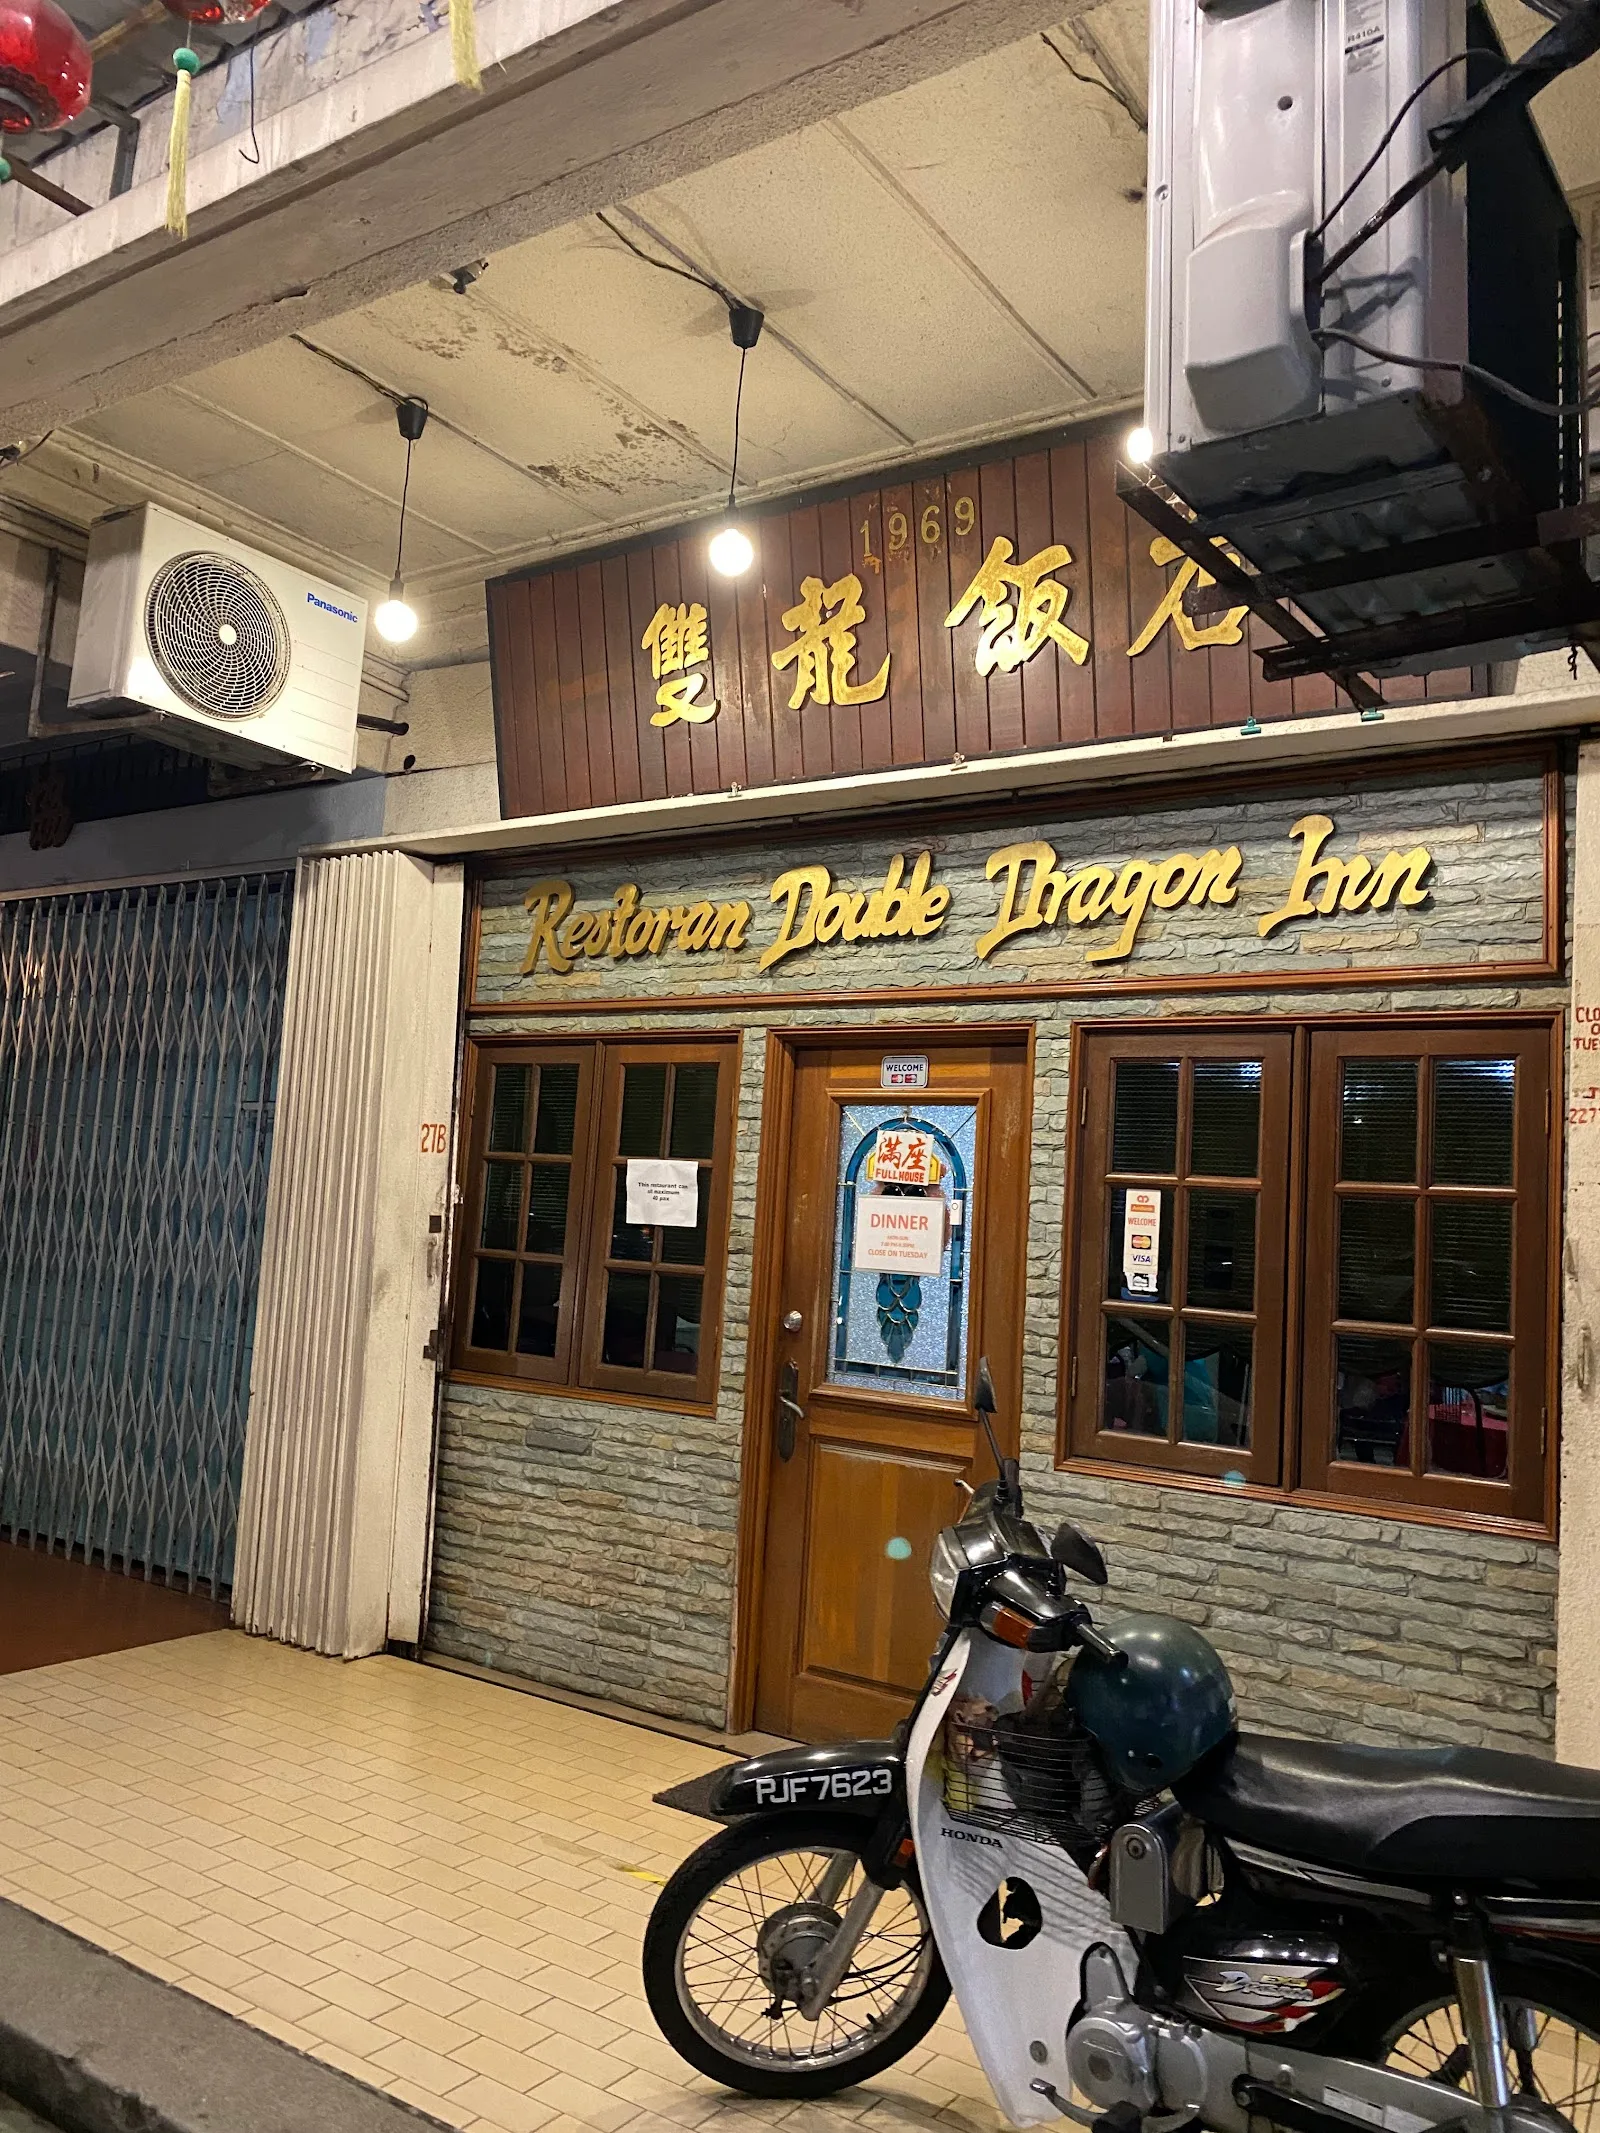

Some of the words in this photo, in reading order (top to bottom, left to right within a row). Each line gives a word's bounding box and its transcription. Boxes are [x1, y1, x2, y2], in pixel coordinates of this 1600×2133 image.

[860, 496, 975, 557] 1969
[307, 592, 358, 623] Panasonic
[520, 879, 752, 974] Restoran
[759, 850, 953, 973] Double
[975, 840, 1243, 962] Dragon
[1257, 814, 1432, 938] Inn
[886, 1064, 924, 1072] WELCOME
[421, 1123, 447, 1154] 27B
[876, 1168, 898, 1180] FULL
[898, 1171, 925, 1183] HOUSE
[871, 1213, 929, 1231] DINNER
[1128, 1217, 1157, 1227] WELCOME
[868, 1248, 886, 1257] CLOSE
[887, 1250, 898, 1258] ON
[899, 1250, 928, 1259] TUESDAY
[1132, 1254, 1151, 1262] VISA
[941, 1827, 1003, 1848] HONDA
